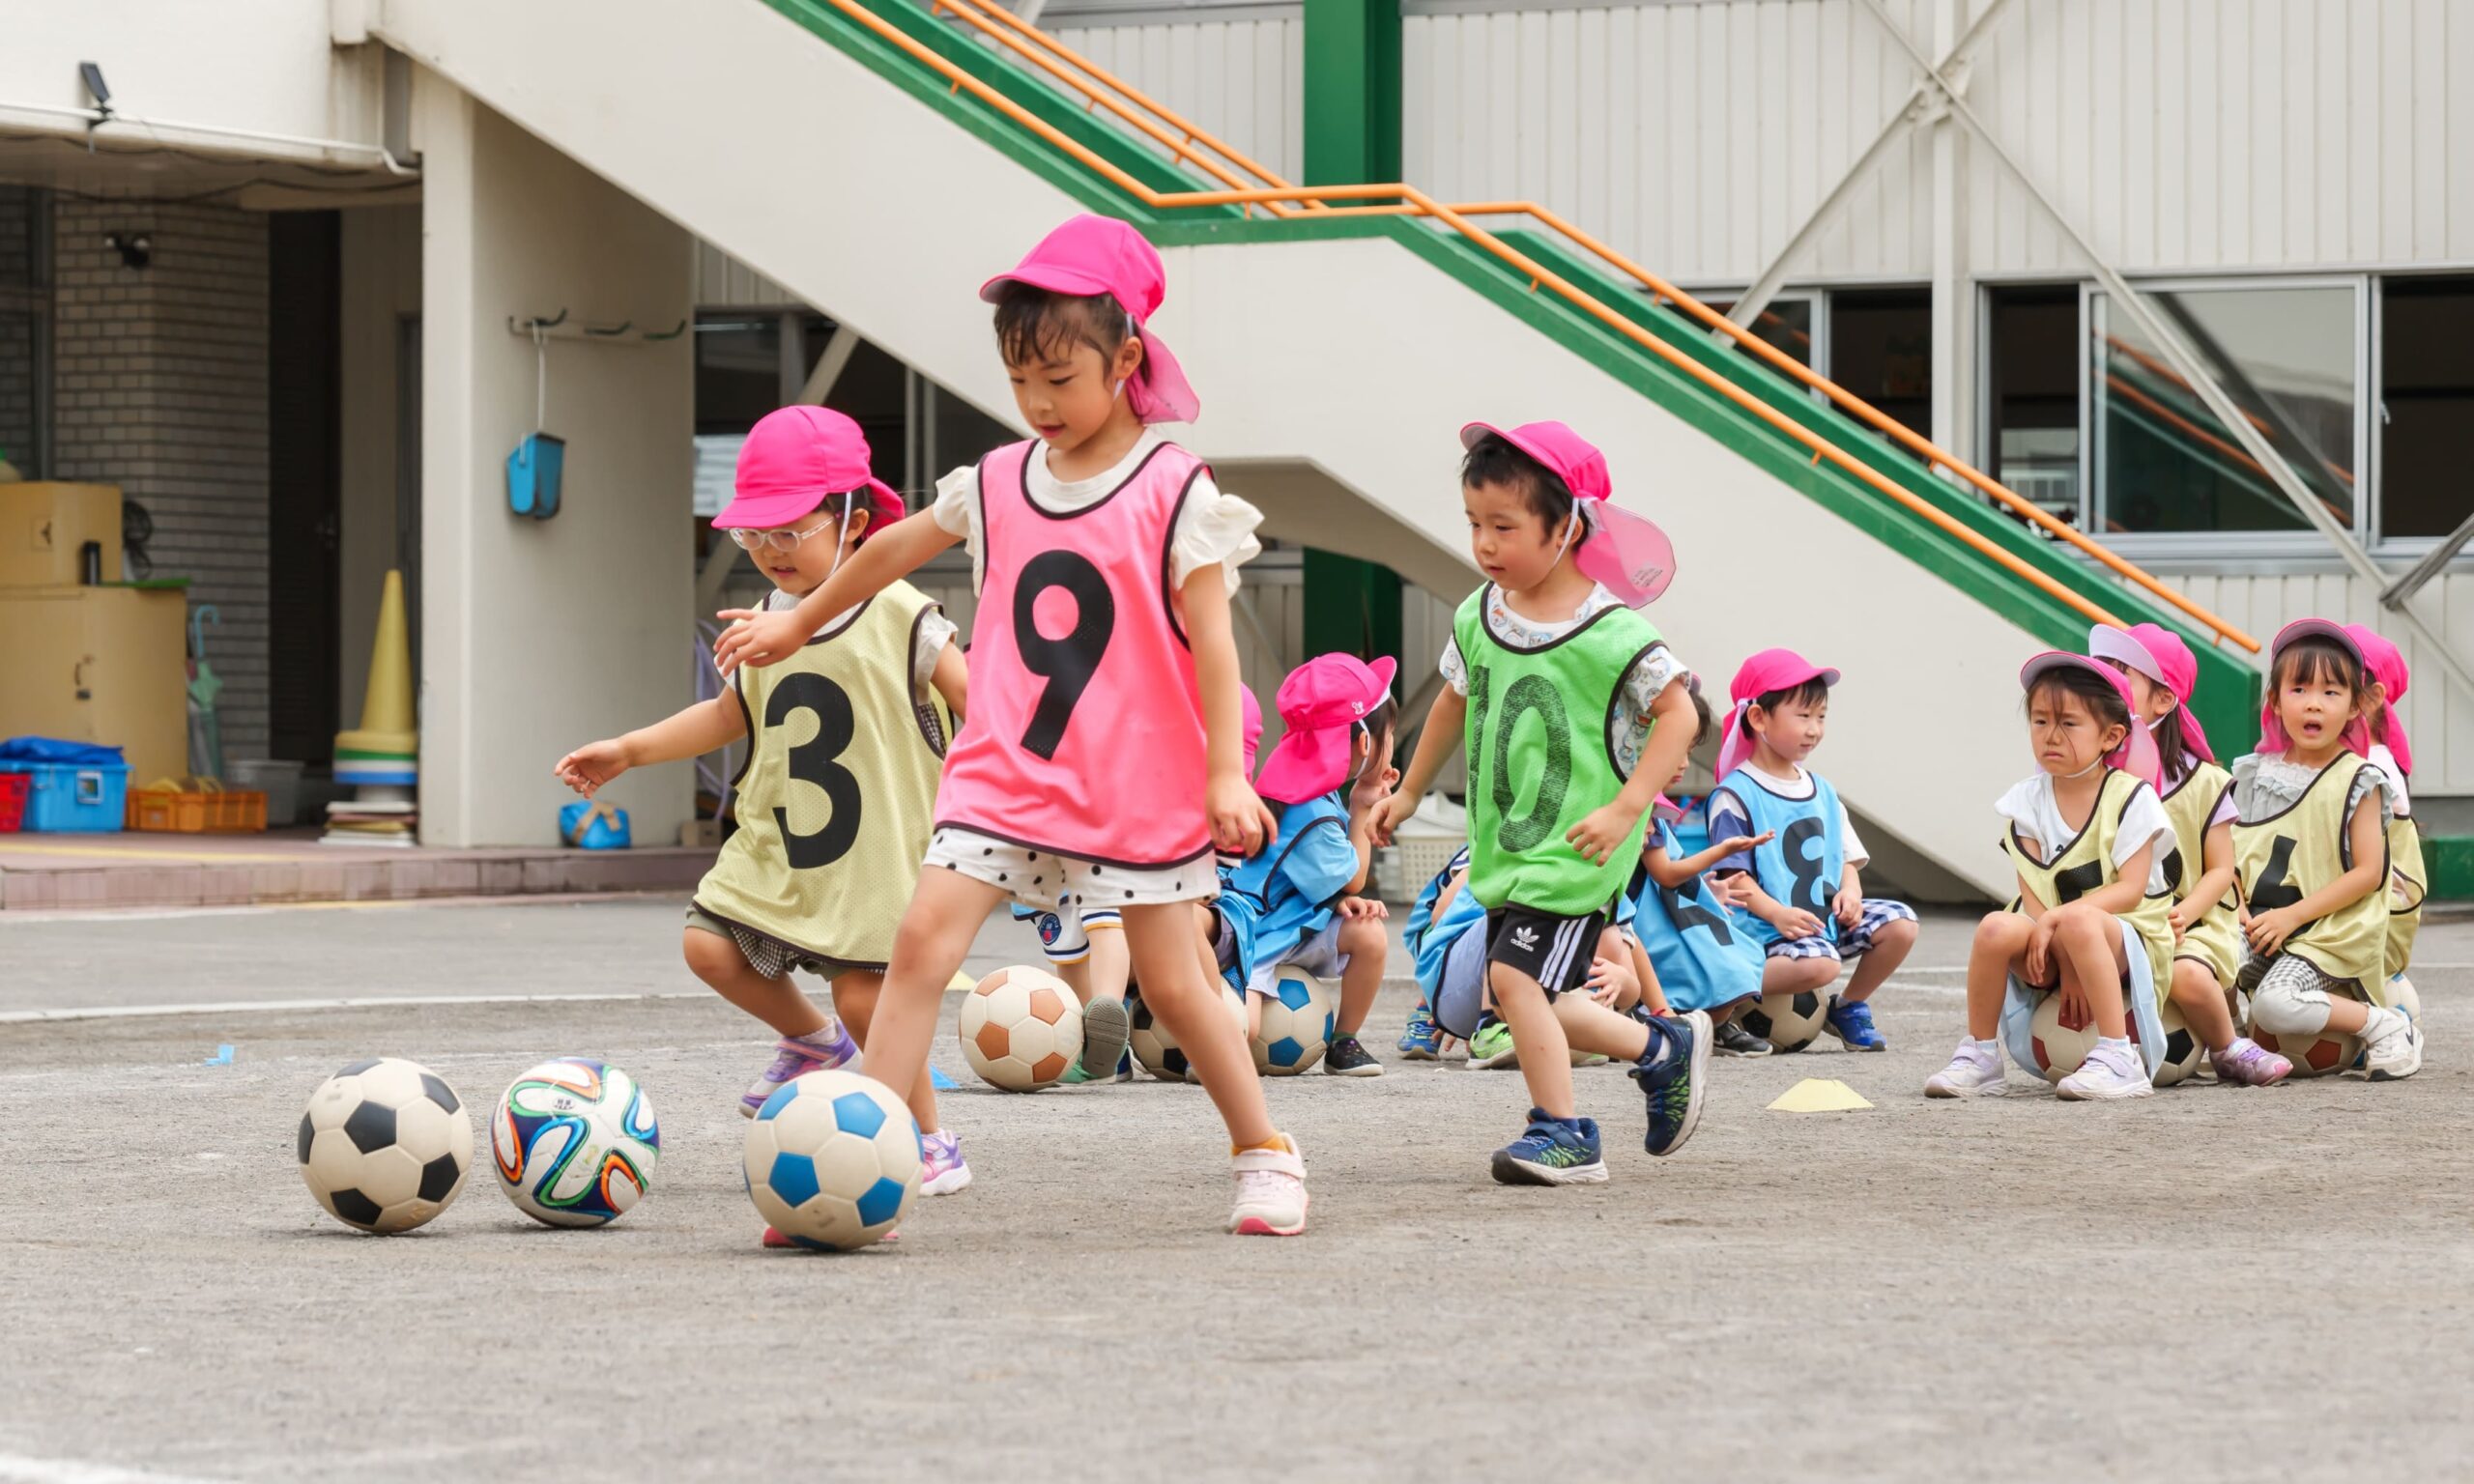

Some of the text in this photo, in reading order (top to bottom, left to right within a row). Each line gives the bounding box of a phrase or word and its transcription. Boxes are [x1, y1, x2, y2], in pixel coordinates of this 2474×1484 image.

[1014, 550, 1115, 761] 9
[764, 672, 862, 870] 3
[1468, 665, 1572, 853] 10
[1510, 937, 1535, 953] adidas
